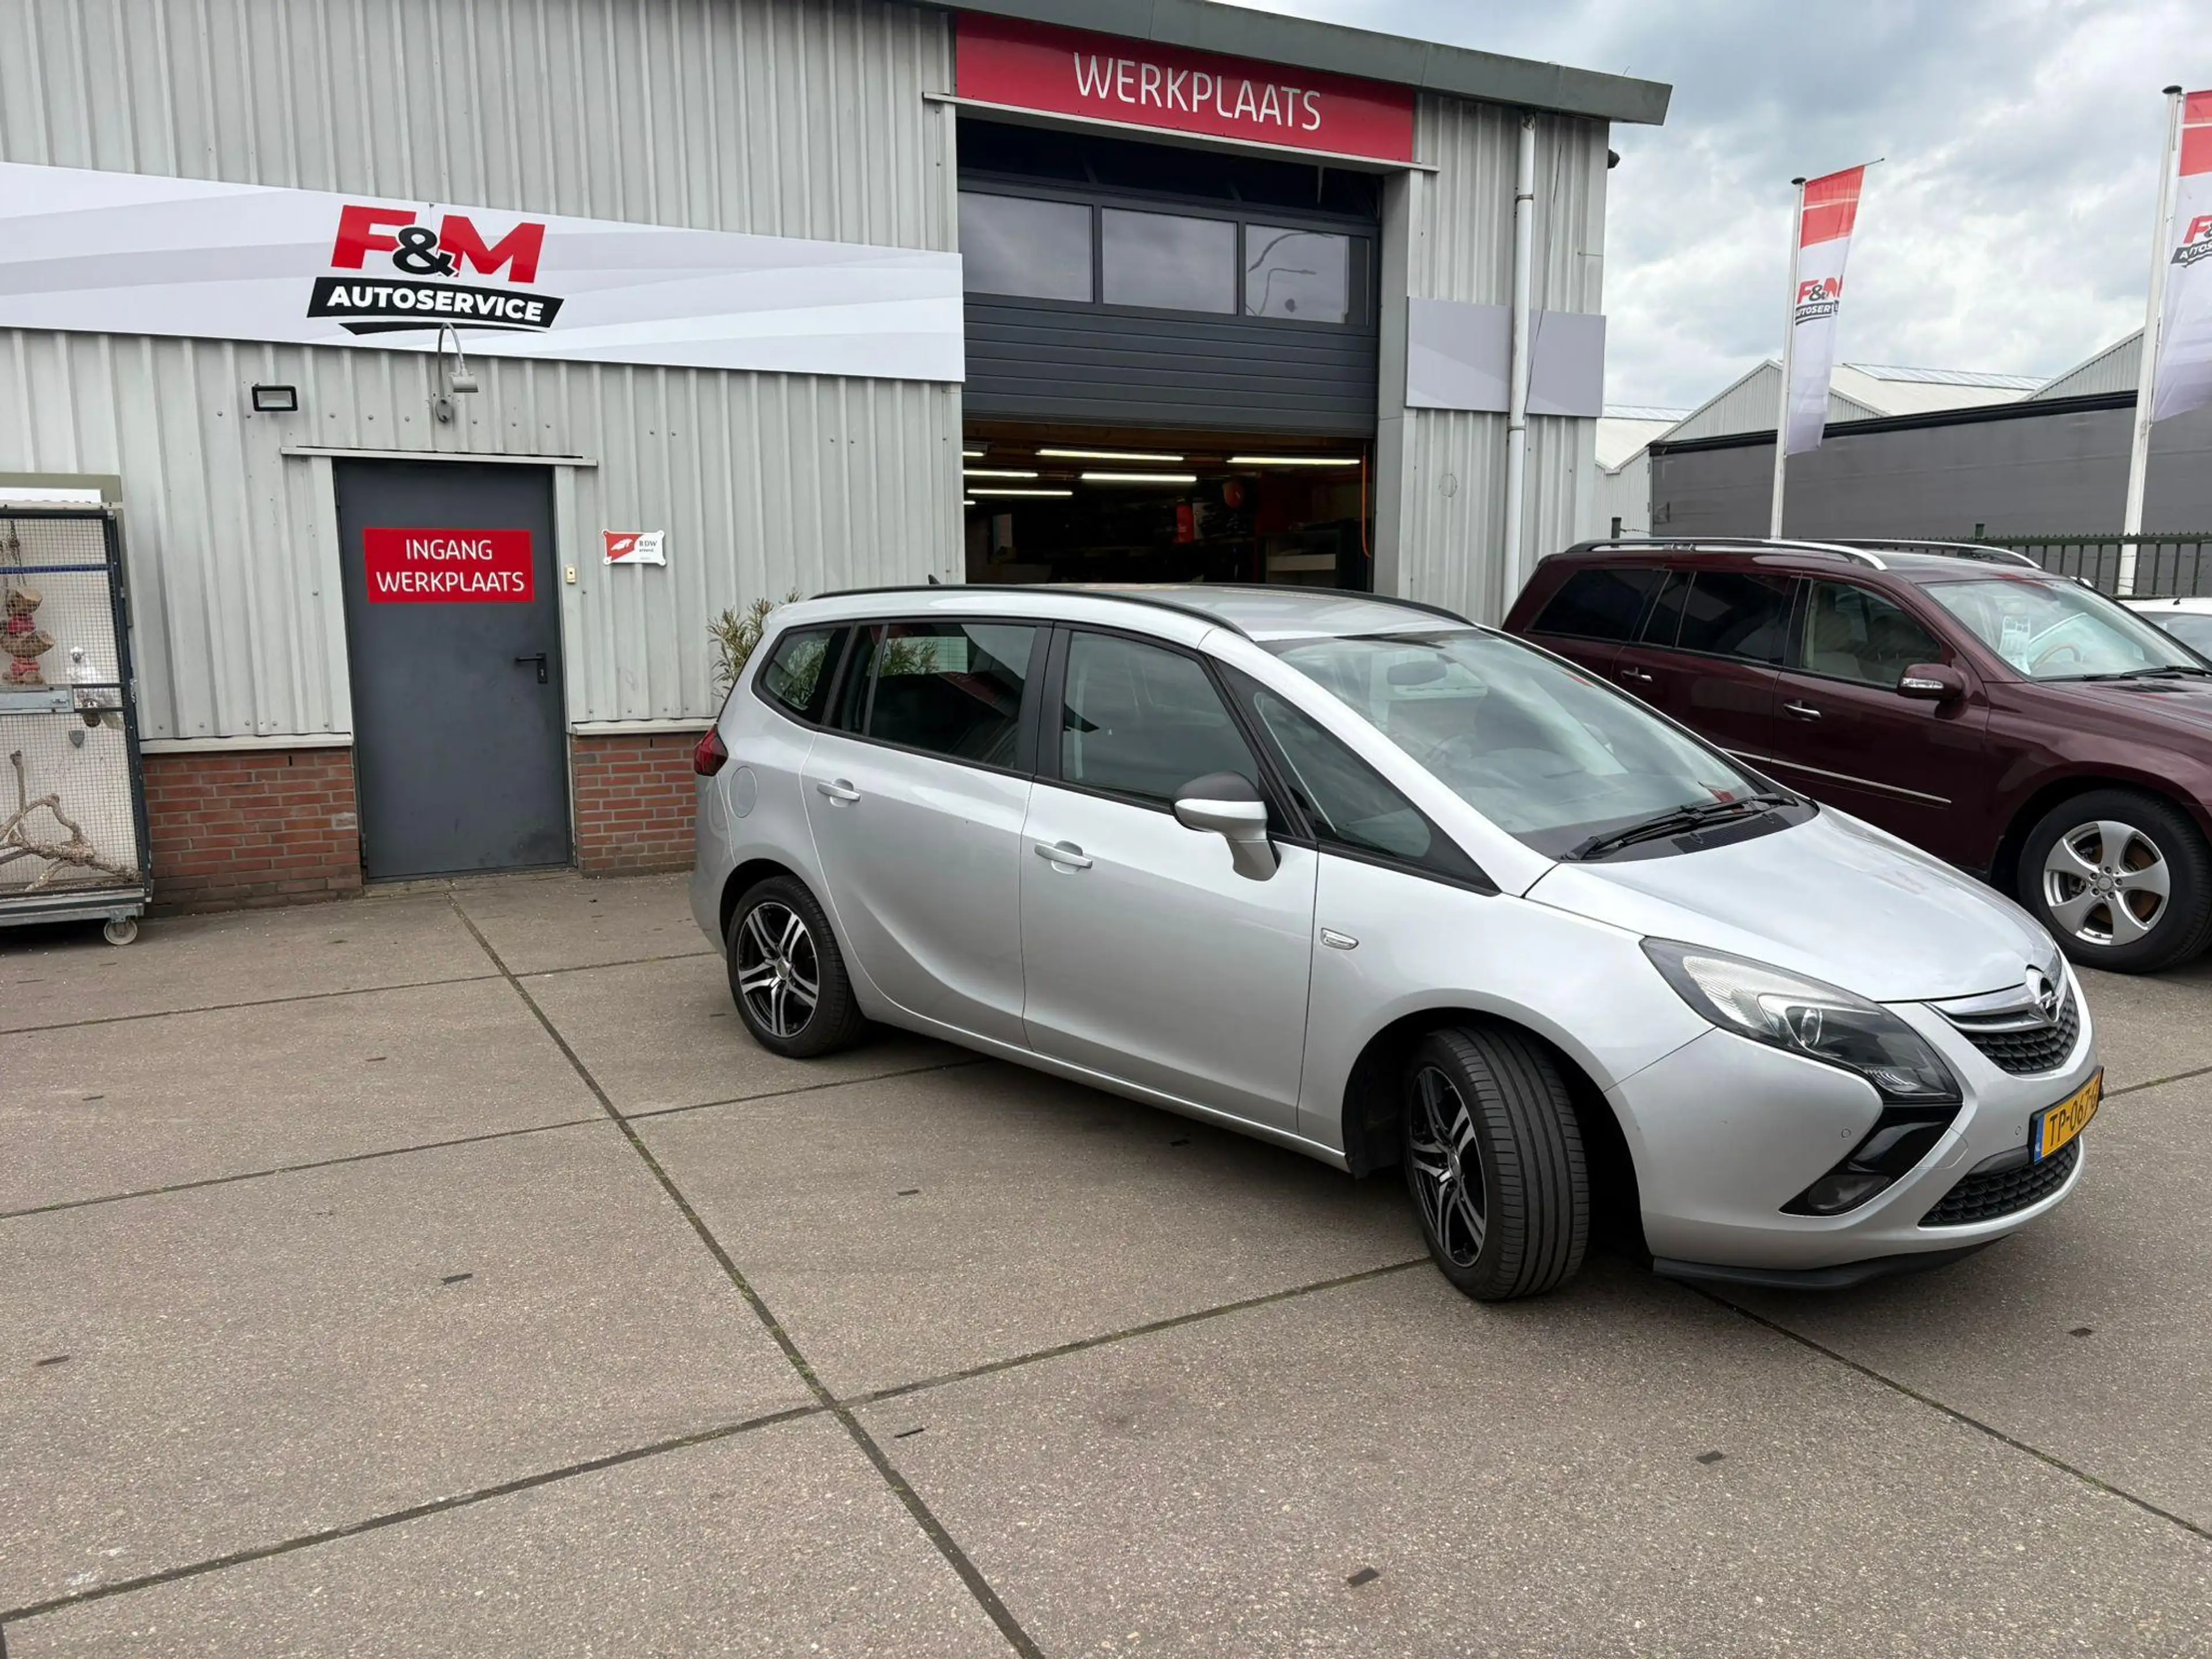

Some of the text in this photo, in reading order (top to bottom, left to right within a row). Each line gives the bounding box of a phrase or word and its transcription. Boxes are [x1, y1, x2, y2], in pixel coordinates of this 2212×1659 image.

[1074, 51, 1321, 131] WERKPLAATS
[331, 204, 546, 283] F&M
[327, 286, 544, 322] AUTOSERVICE
[406, 539, 493, 560] INGANG
[376, 571, 525, 593] WERKPLAATS
